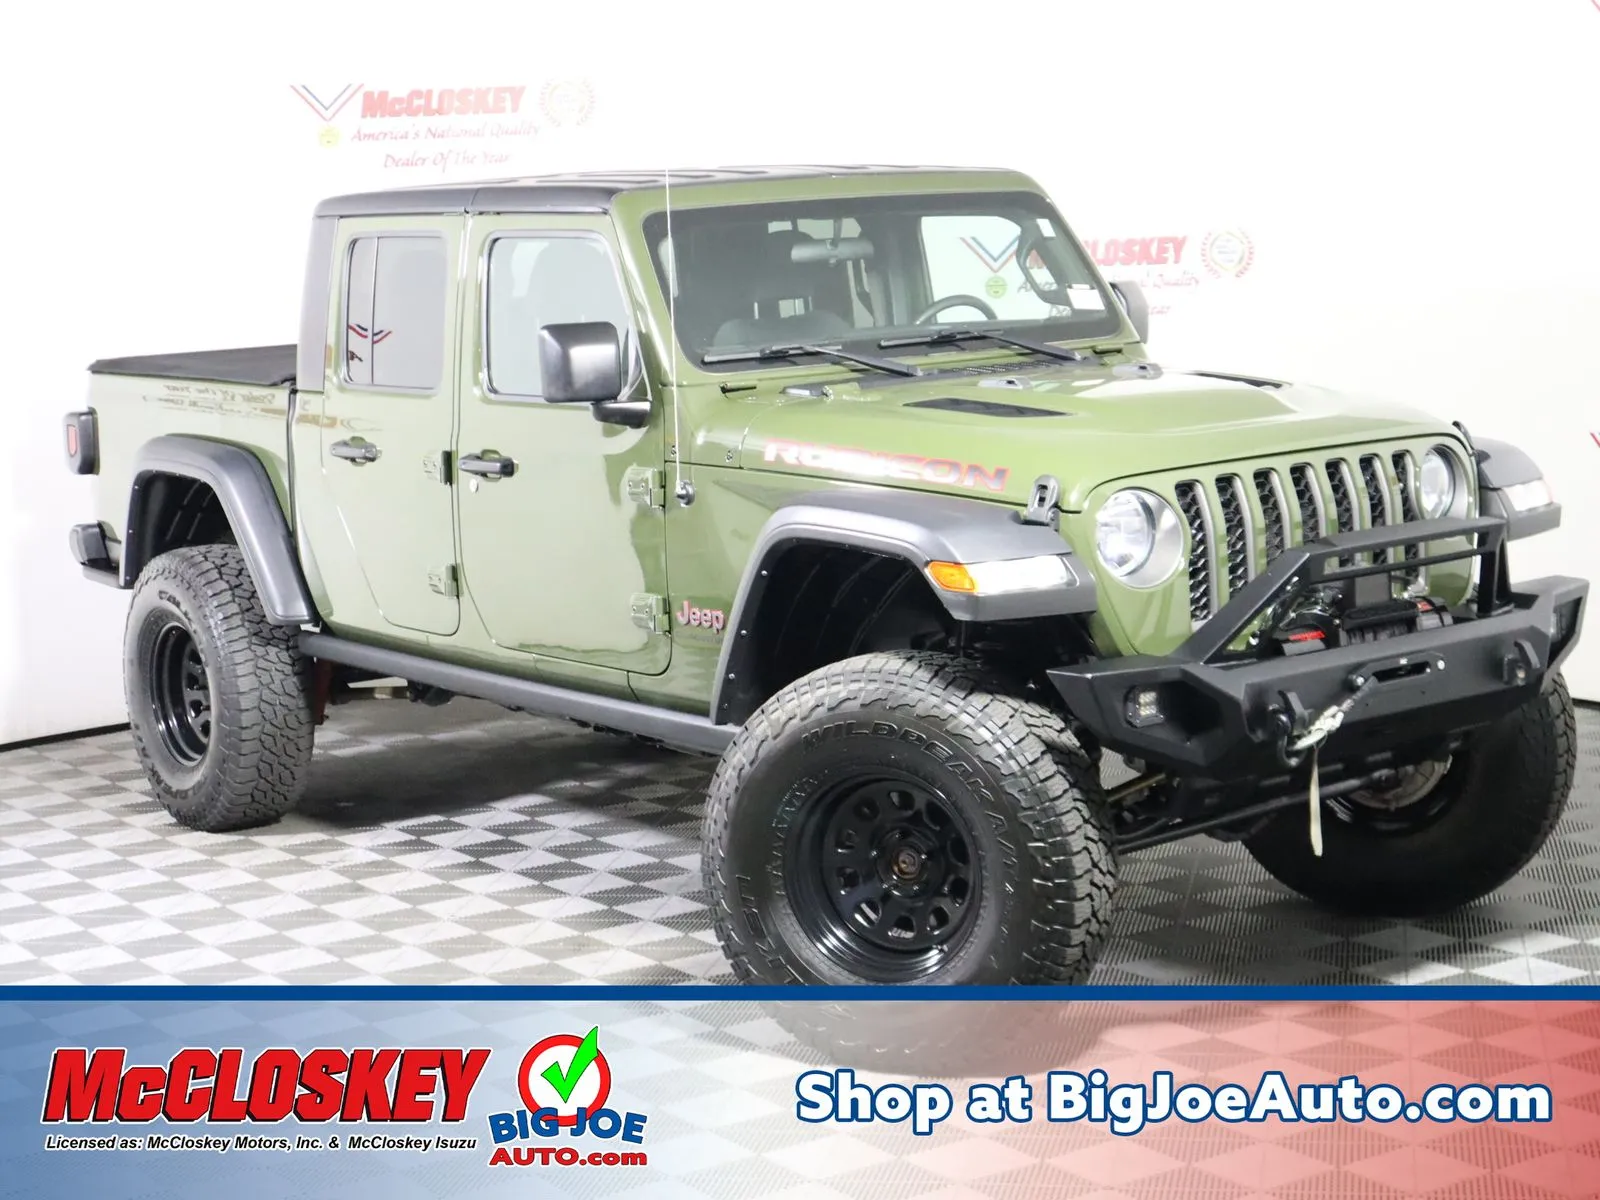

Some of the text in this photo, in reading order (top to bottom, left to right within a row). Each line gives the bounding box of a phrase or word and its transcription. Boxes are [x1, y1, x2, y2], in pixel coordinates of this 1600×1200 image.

[361, 85, 526, 119] McCLOSKEY
[351, 119, 541, 143] America's National Quality
[383, 149, 429, 169] Dealer
[432, 149, 452, 173] Of
[454, 148, 478, 166] The
[763, 438, 1010, 492] RUBICON
[676, 601, 724, 634] Jeep
[801, 719, 995, 803] WILDPEAK
